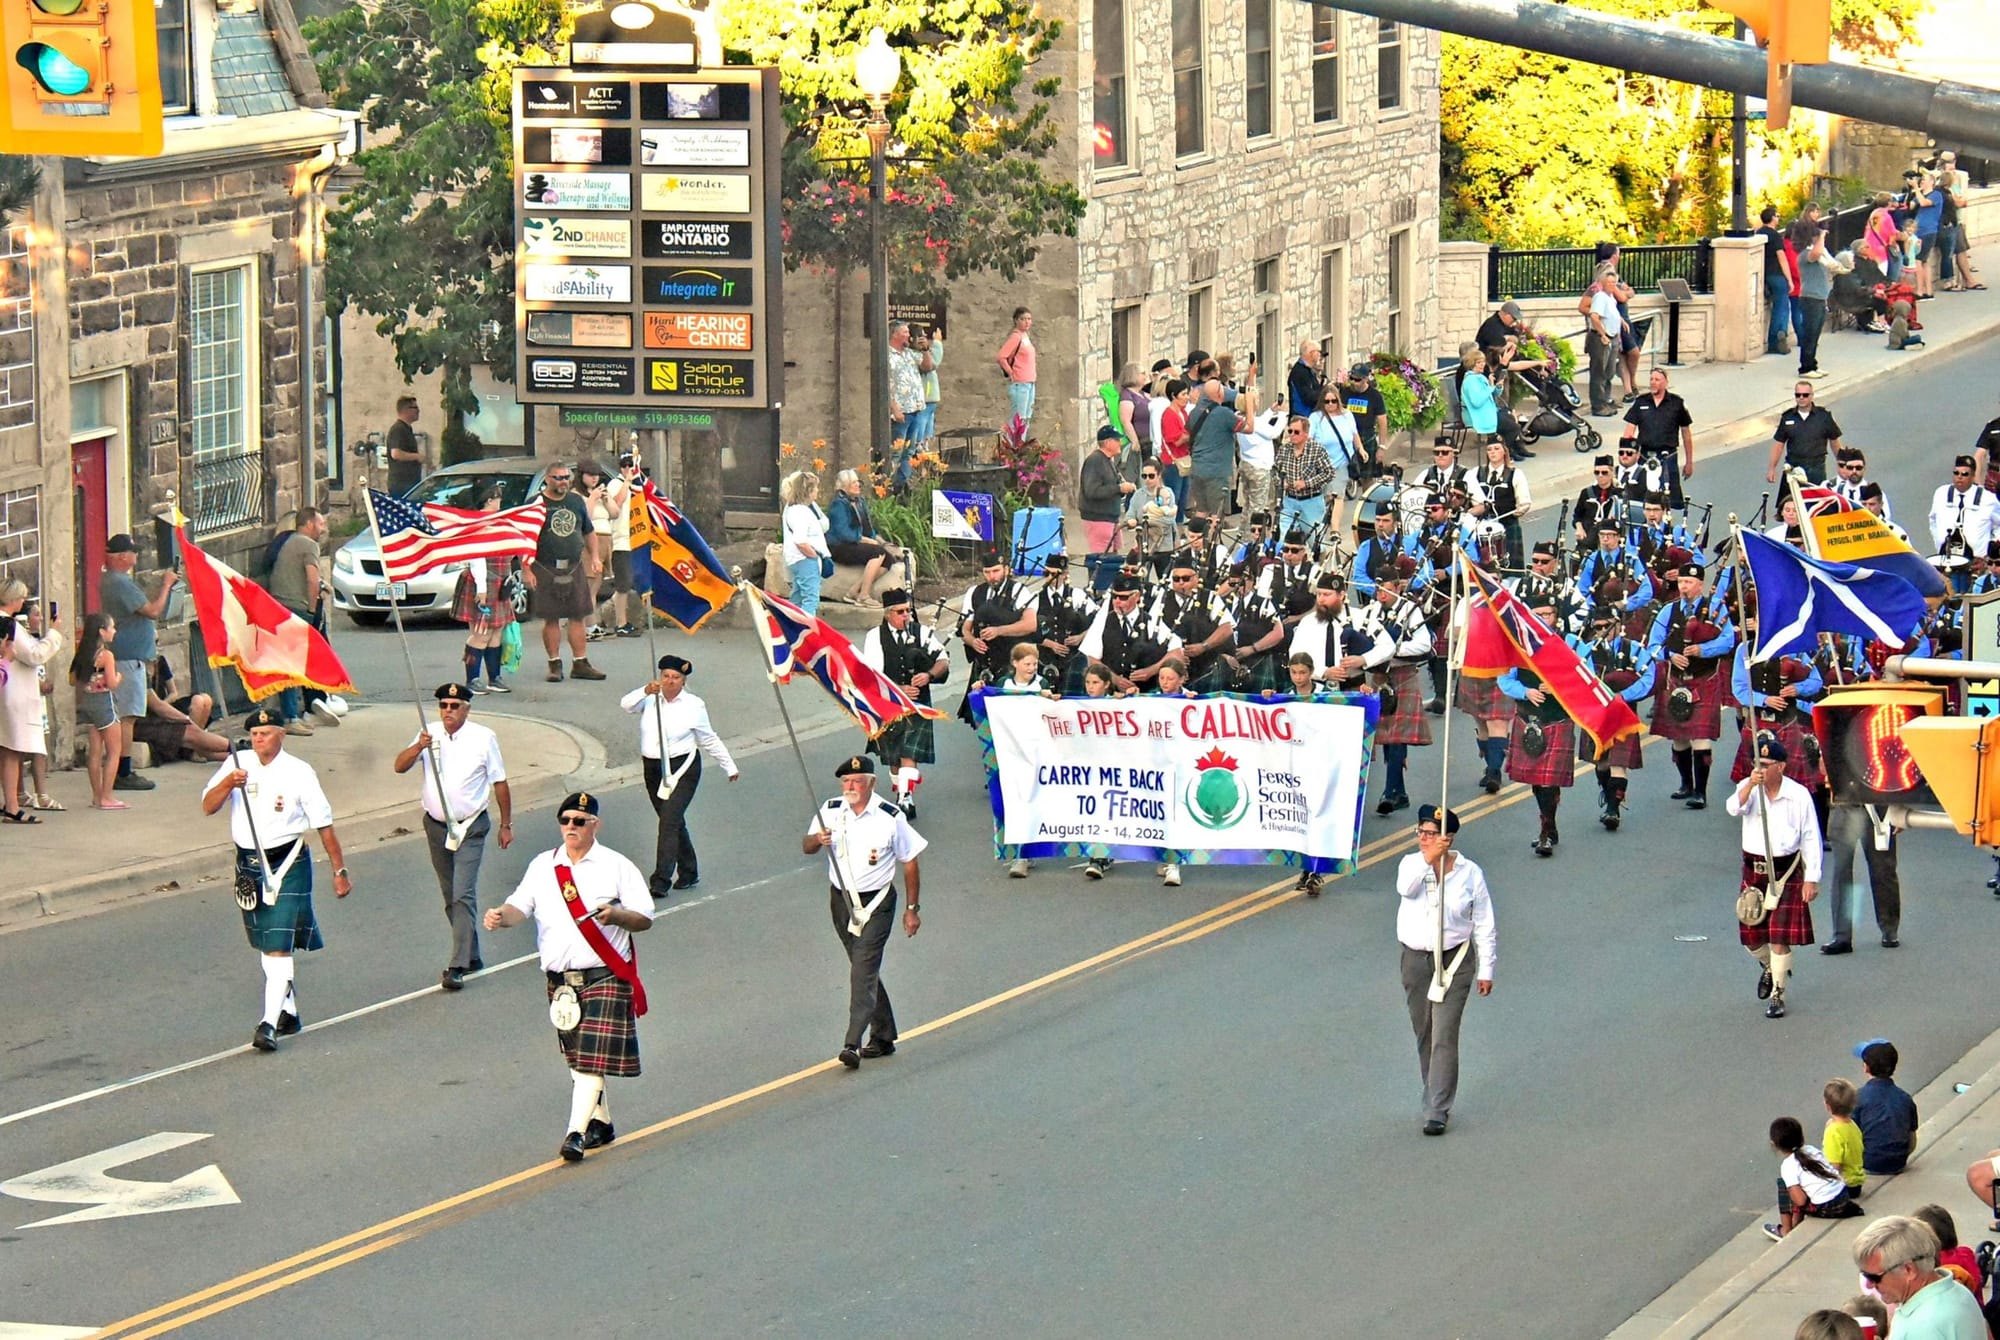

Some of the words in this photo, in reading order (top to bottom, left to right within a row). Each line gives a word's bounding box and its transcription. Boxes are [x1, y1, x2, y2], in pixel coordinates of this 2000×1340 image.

[588, 87, 613, 98] ACTT
[528, 101, 570, 110] Homewood
[550, 177, 582, 188] Riverside
[584, 178, 611, 191] Massage
[559, 192, 584, 205] Therapy
[586, 193, 599, 202] and
[601, 192, 629, 203] Wellness
[552, 226, 583, 242] 2ND
[584, 231, 627, 243] CHANCE
[661, 223, 730, 234] EMPLOYMENT
[661, 233, 730, 246] ONTARIO
[660, 281, 718, 299] Integrate
[896, 311, 936, 319] Entrance
[649, 316, 676, 326] Ward
[676, 316, 747, 331] HEARING
[688, 332, 747, 347] CENTRE
[537, 366, 572, 378] BLR
[683, 362, 733, 373] Salon
[683, 374, 745, 388] Chique
[565, 412, 593, 424] Space
[594, 413, 608, 422] for
[610, 413, 636, 424] Lease
[644, 413, 711, 425] 519-993-3660
[1076, 709, 1140, 737] PIPES
[1147, 720, 1173, 738] ARE
[1038, 765, 1091, 785] CARRY
[1098, 766, 1123, 787] ME
[1129, 768, 1165, 792] BACK
[1076, 795, 1096, 815] TO
[1103, 789, 1165, 821] FERGUS
[1038, 822, 1084, 838] August
[1087, 824, 1100, 835] 12
[1113, 826, 1131, 839] 14,
[1135, 827, 1165, 840] 2022
